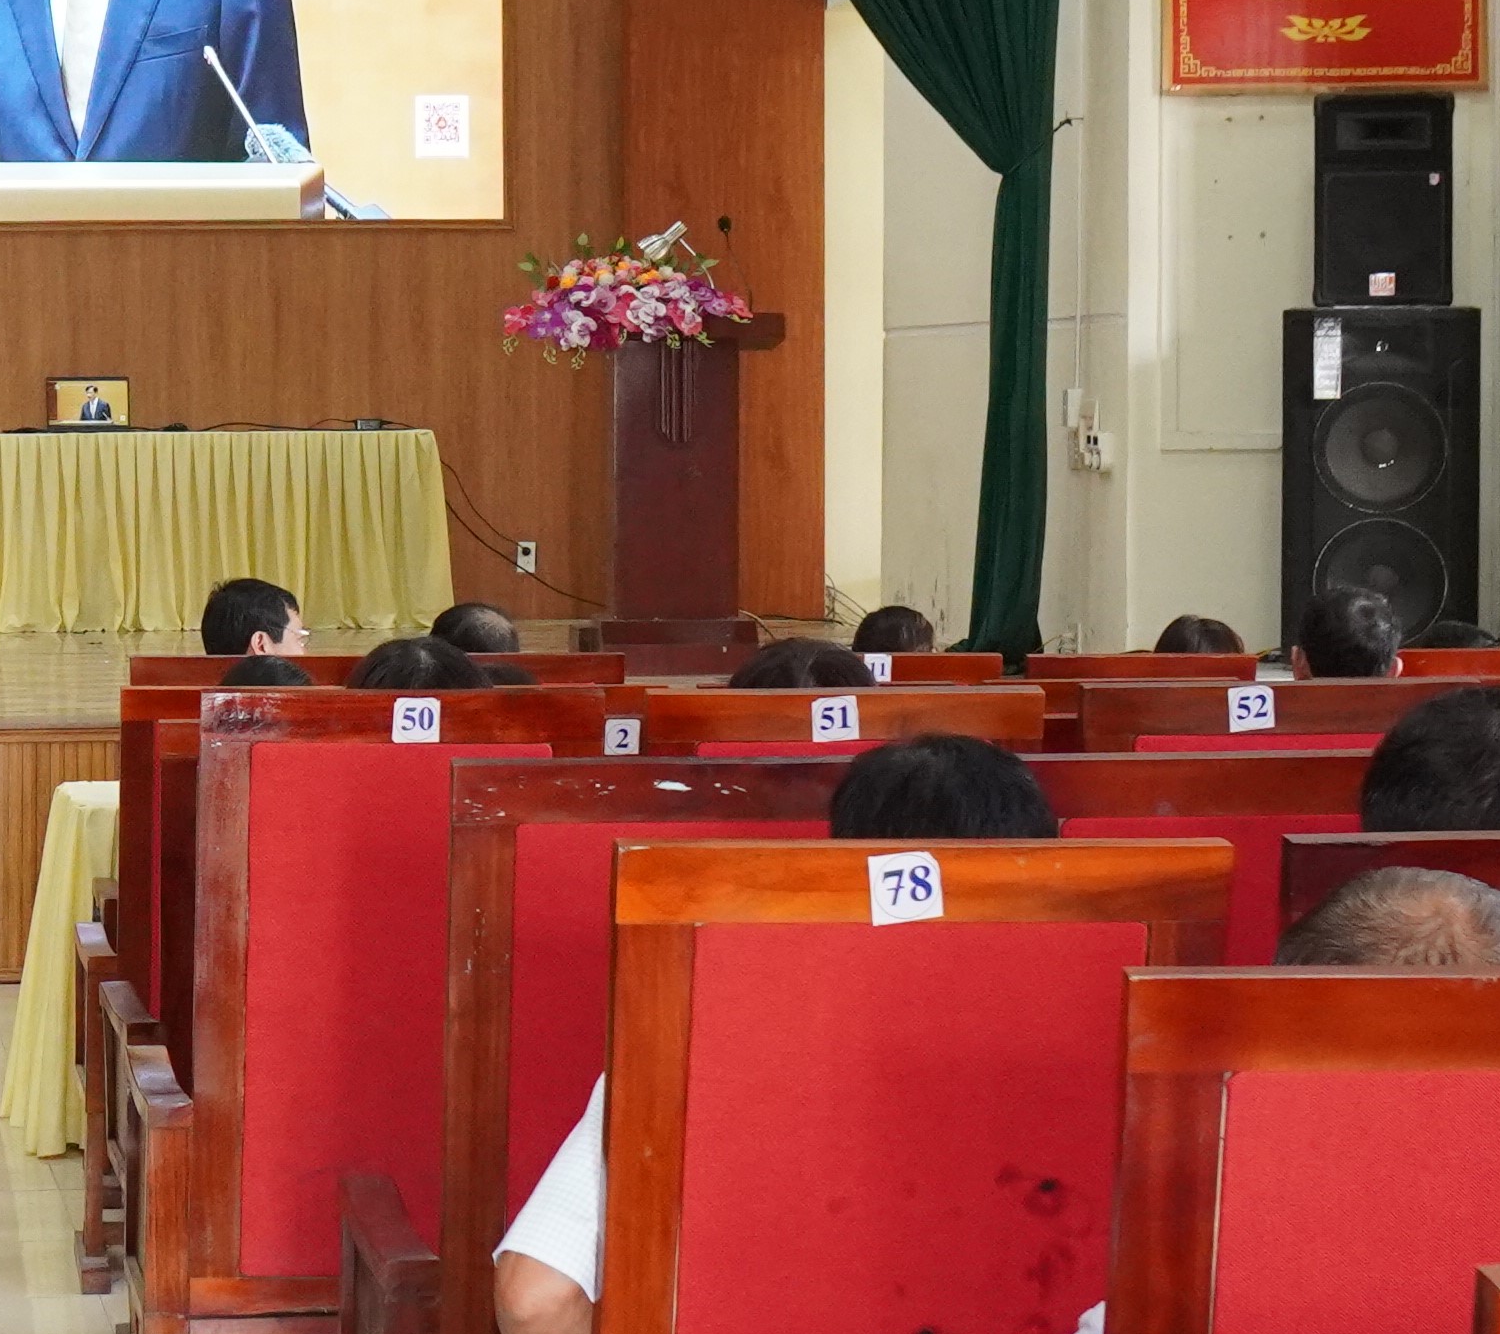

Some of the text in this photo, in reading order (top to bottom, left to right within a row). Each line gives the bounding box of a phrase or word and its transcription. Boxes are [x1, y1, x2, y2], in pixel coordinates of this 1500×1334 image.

[401, 706, 434, 731] 50
[820, 705, 850, 731] 51
[1236, 694, 1268, 720] 52
[615, 728, 629, 749] 2
[883, 865, 933, 906] 78
